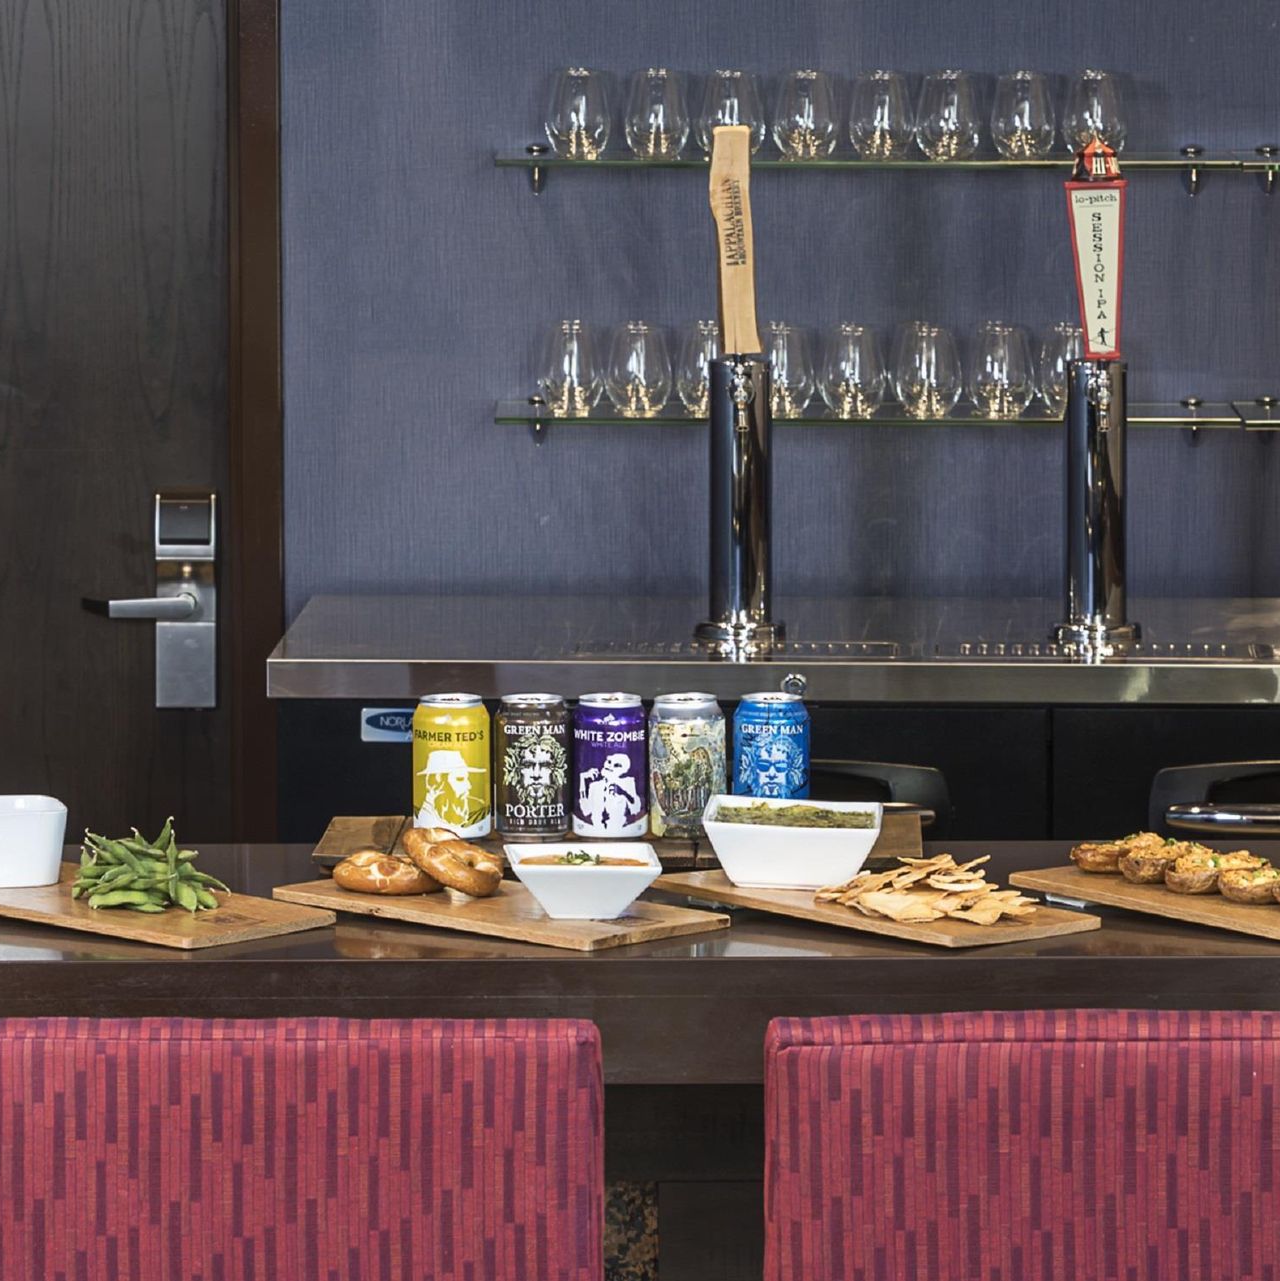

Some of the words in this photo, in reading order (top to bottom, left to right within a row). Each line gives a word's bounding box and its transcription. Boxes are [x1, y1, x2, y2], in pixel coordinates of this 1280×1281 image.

[1091, 212, 1105, 283] SESSION
[1096, 288, 1107, 320] IPA
[414, 728, 452, 742] FARMER
[455, 729, 484, 742] TED'S
[503, 723, 540, 735] GREEN
[543, 723, 566, 735] MAN
[574, 728, 604, 742] WHITE
[606, 729, 645, 742] ZOMBIE
[741, 723, 777, 734] GREEN
[780, 724, 804, 734] MAN
[505, 803, 565, 818] PORTER
